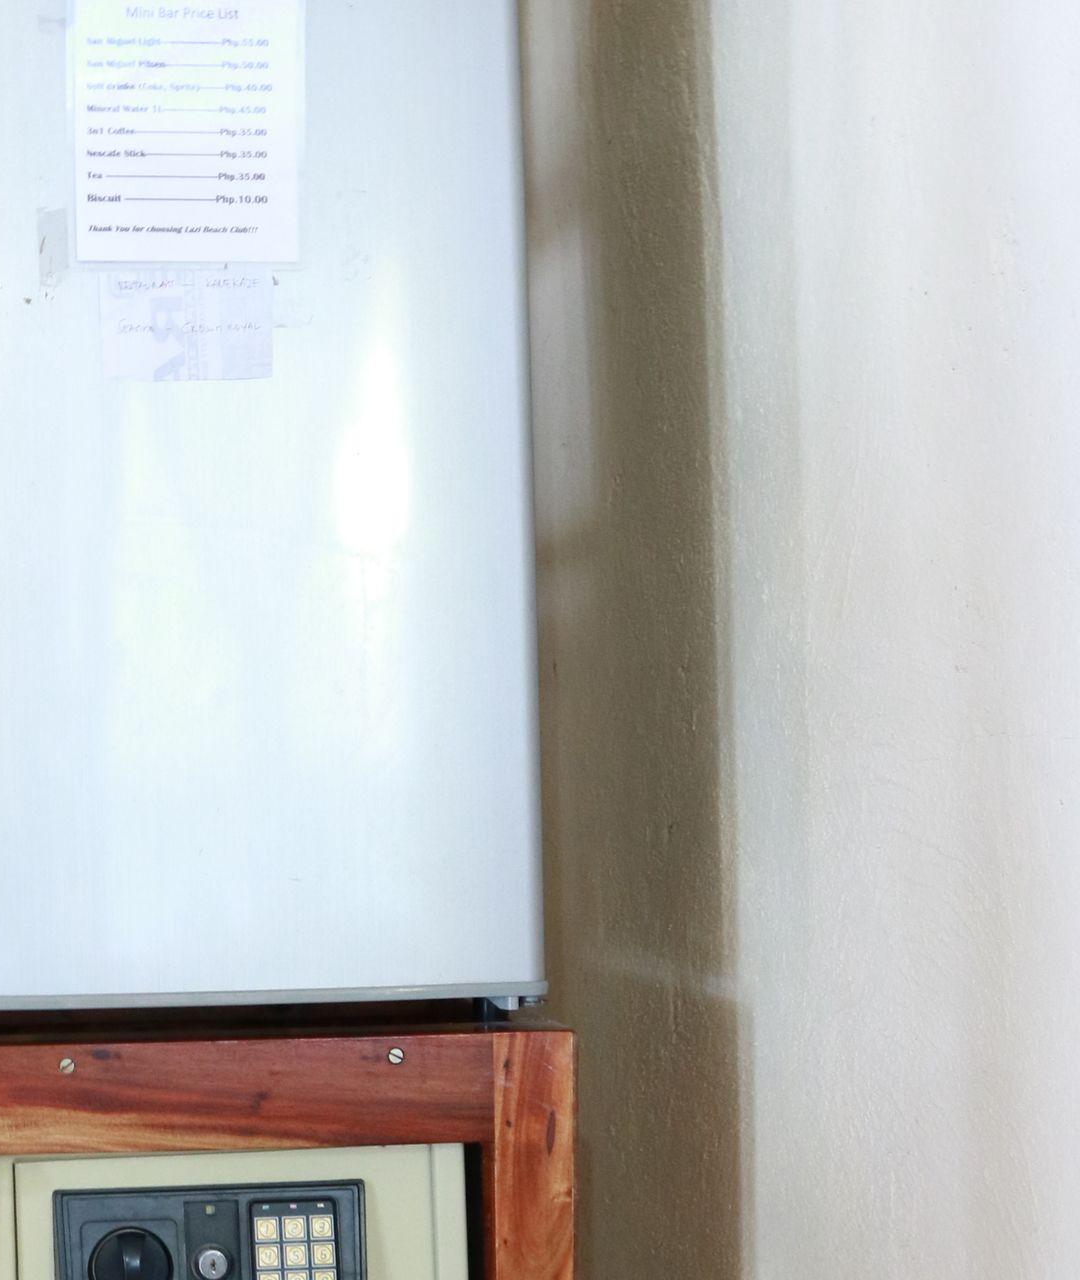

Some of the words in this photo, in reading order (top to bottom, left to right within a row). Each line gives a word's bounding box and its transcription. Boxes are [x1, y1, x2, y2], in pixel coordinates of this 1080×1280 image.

[126, 7, 154, 18] Mini
[158, 7, 179, 18] Bar
[183, 7, 215, 19] Price
[218, 8, 239, 20] List
[87, 194, 121, 202] Biscuit
[215, 195, 268, 205] Php.10.00
[88, 225, 112, 233] Thank
[115, 225, 130, 233] You
[132, 225, 144, 233] for
[146, 225, 182, 234] choosing
[203, 226, 228, 234] Beach
